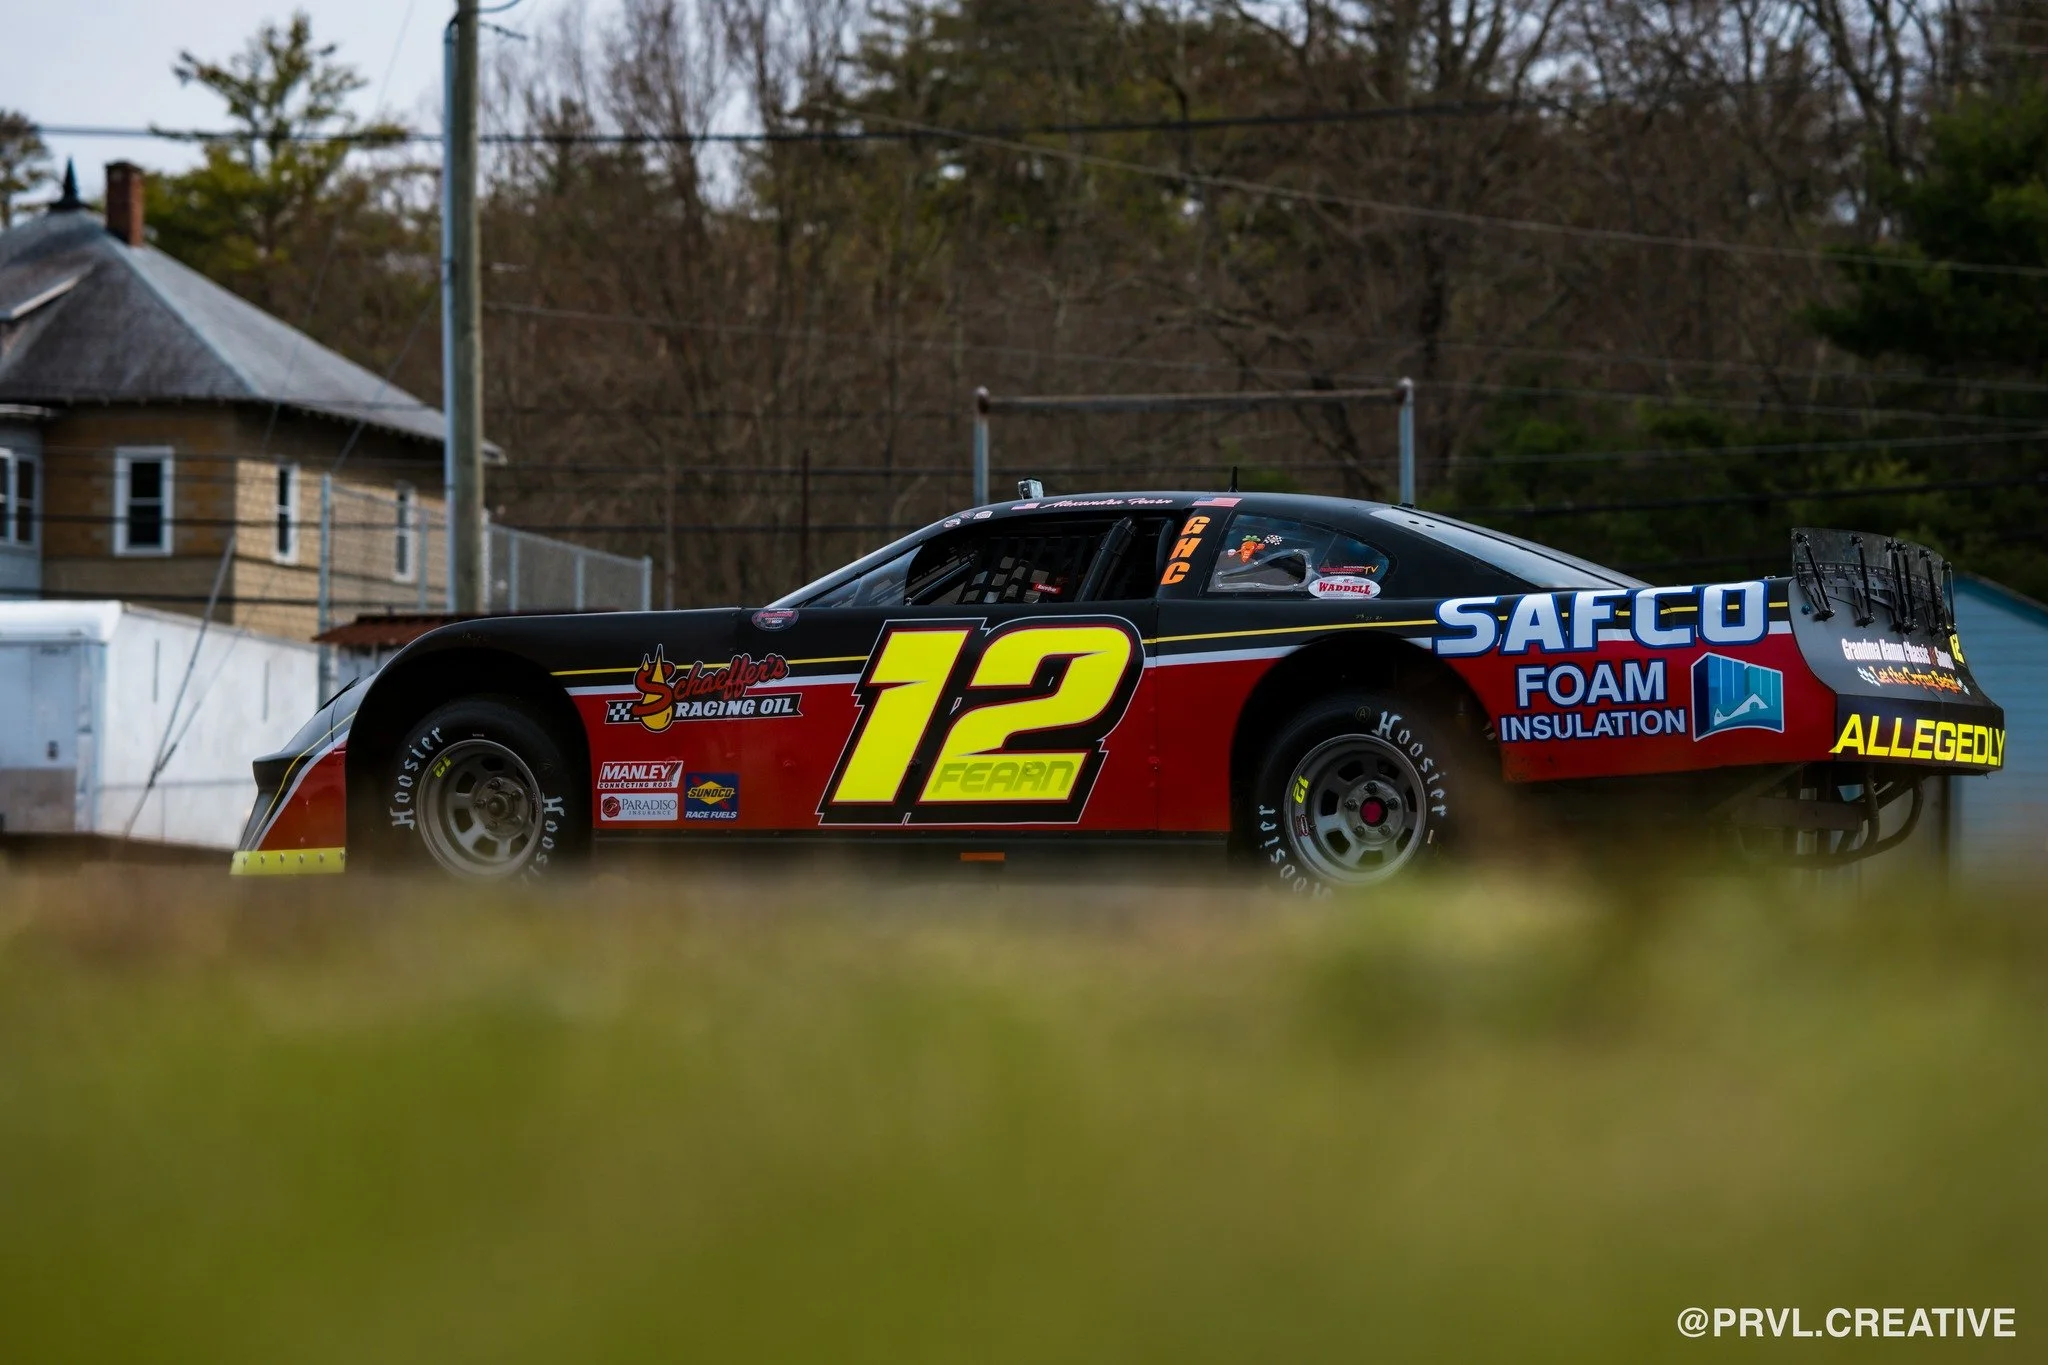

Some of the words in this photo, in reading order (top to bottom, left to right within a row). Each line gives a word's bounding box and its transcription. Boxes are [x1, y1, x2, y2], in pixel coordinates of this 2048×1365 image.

[1161, 516, 1211, 585] GHC
[1319, 582, 1371, 595] WADDELL
[1434, 580, 1769, 657] SAFCO
[632, 654, 789, 717] Schaeffer's
[1515, 658, 1668, 709] FOAM
[675, 699, 755, 718] RACING
[759, 697, 794, 714] OIL
[831, 626, 1132, 803] 12
[1500, 708, 1687, 743] INSULATION
[1829, 713, 2007, 768] ALLEGEDLY
[389, 726, 444, 830] Hoosier
[602, 764, 671, 780] MANLEY
[930, 760, 1075, 794] FEARN
[1371, 710, 1447, 818] Hoosier
[621, 798, 678, 811] PARADISO
[689, 788, 733, 798] SUNOCO
[685, 811, 709, 819] RACE
[710, 811, 738, 819] FUELS
